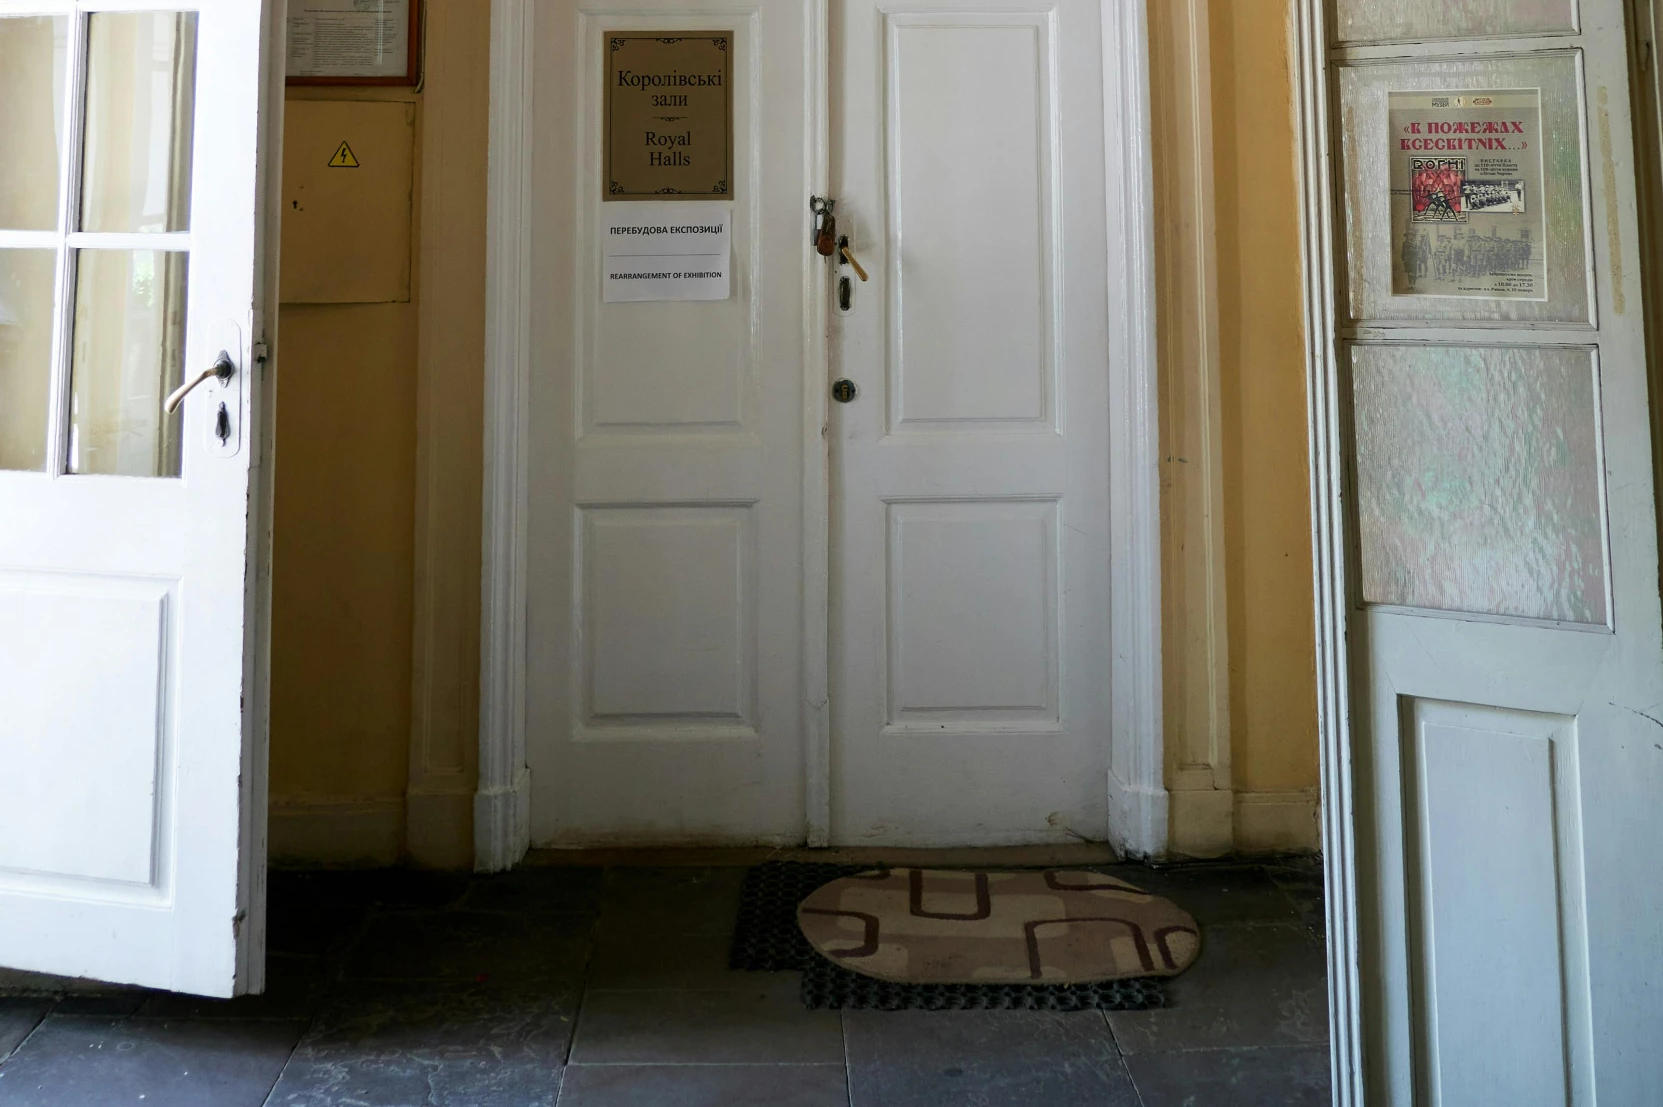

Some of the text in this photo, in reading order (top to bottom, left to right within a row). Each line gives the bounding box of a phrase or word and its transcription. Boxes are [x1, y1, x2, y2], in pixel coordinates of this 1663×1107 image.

[617, 69, 722, 91] Королівські
[651, 94, 689, 107] зали
[1427, 121, 1524, 134] ПОЖЕЖАХ
[645, 131, 692, 150] Royal
[649, 151, 691, 167] Halls
[1413, 159, 1464, 170] ВОГНІ
[610, 223, 724, 236] ПЕРЕБУДОВА ЕКСПОЗИЦІЇ
[609, 272, 672, 280] REARRANGEMENT
[683, 271, 722, 279] EXHIBITION
